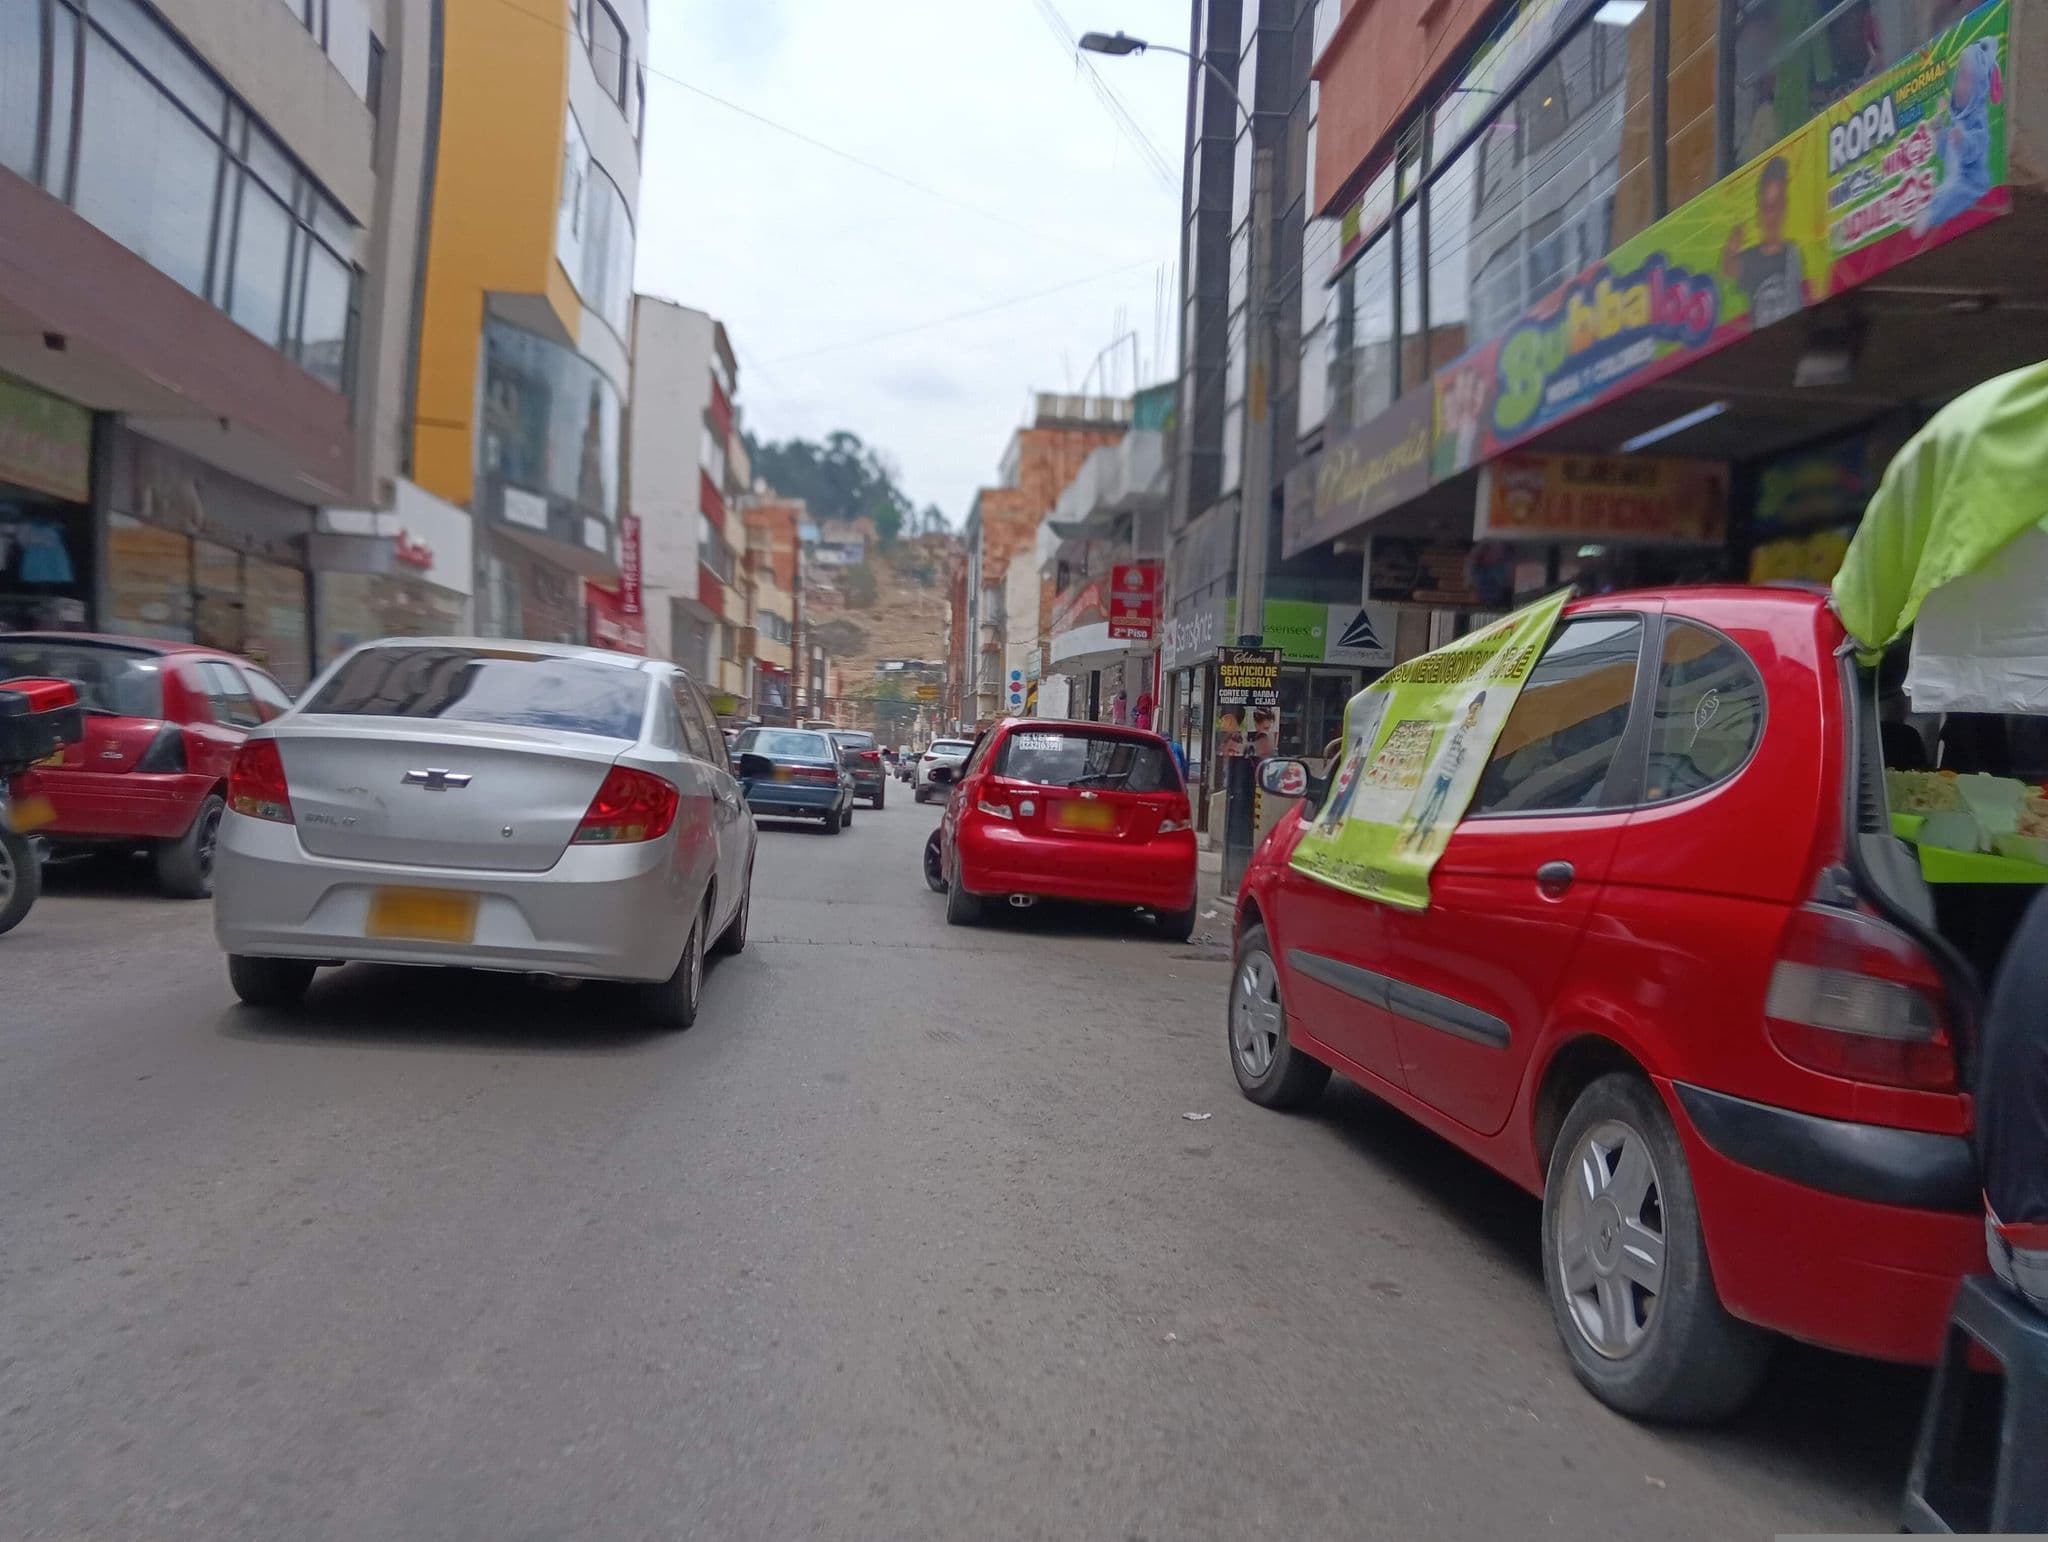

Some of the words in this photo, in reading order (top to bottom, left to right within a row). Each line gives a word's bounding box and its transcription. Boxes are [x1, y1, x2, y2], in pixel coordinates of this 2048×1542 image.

[1895, 61, 1948, 103] INFORMAL
[1829, 95, 1896, 175] ROPA
[1127, 627, 1148, 638] Piso
[1220, 665, 1264, 677] SERVICIO
[1265, 666, 1278, 677] DE
[1224, 676, 1272, 688] BARBERIA
[1219, 689, 1240, 697] CORTE
[1255, 697, 1276, 705] CEJAS
[304, 813, 338, 825] SAIL
